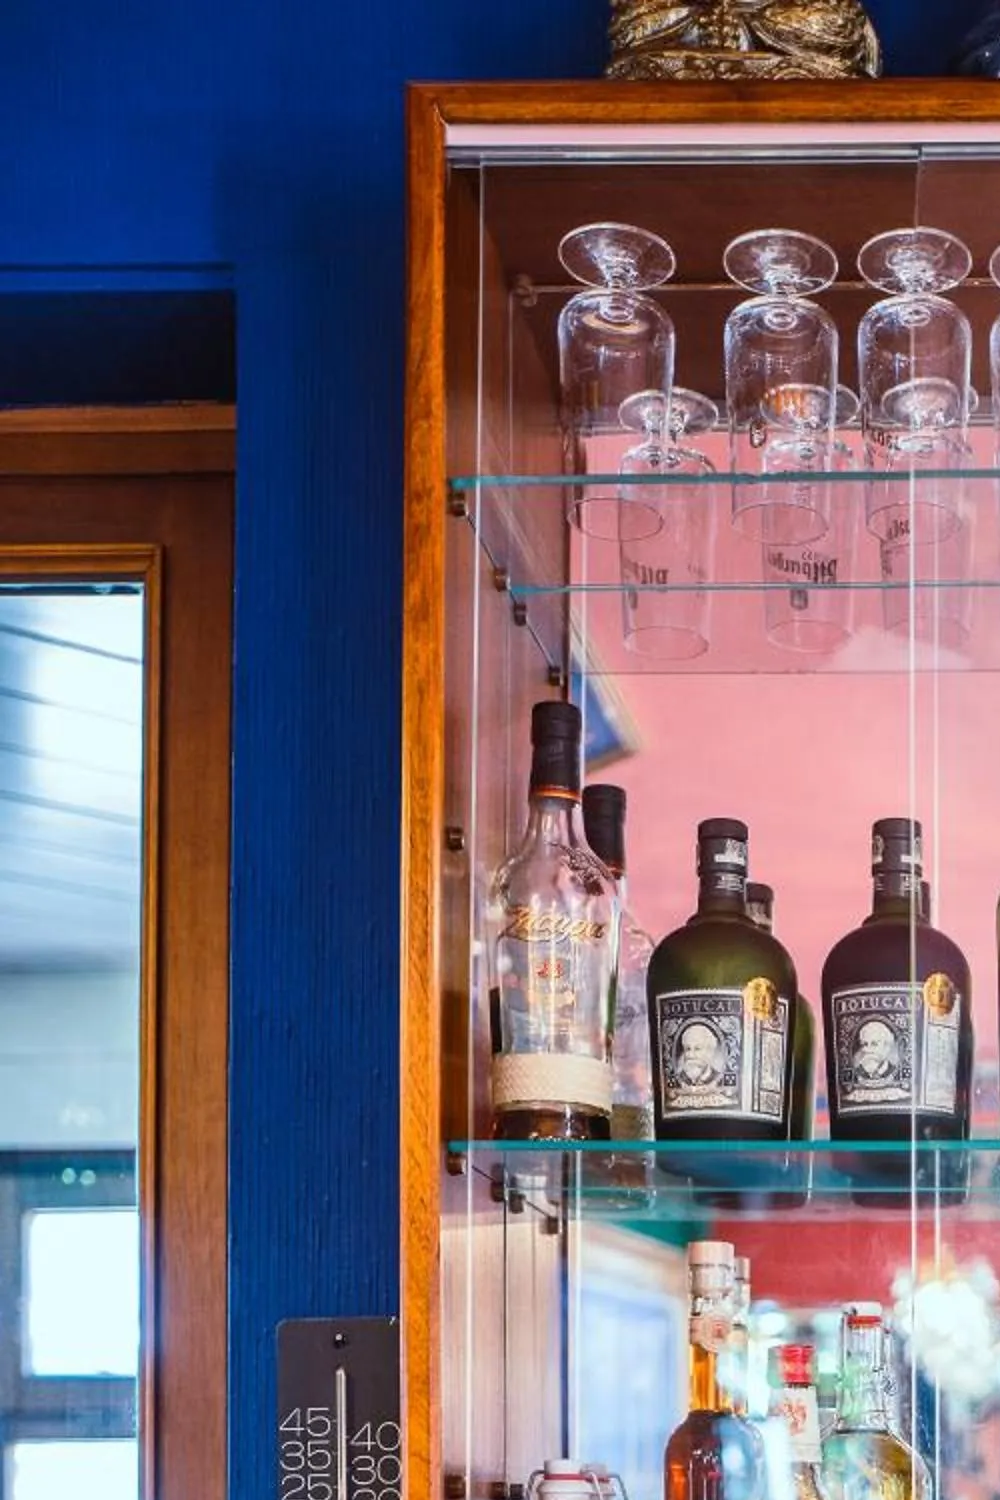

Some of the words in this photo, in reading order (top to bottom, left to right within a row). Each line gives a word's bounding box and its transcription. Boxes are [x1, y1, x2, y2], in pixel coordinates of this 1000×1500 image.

[279, 1407, 332, 1437] 45
[350, 1421, 401, 1451] 40
[279, 1441, 332, 1471] 35
[352, 1455, 401, 1485] 30
